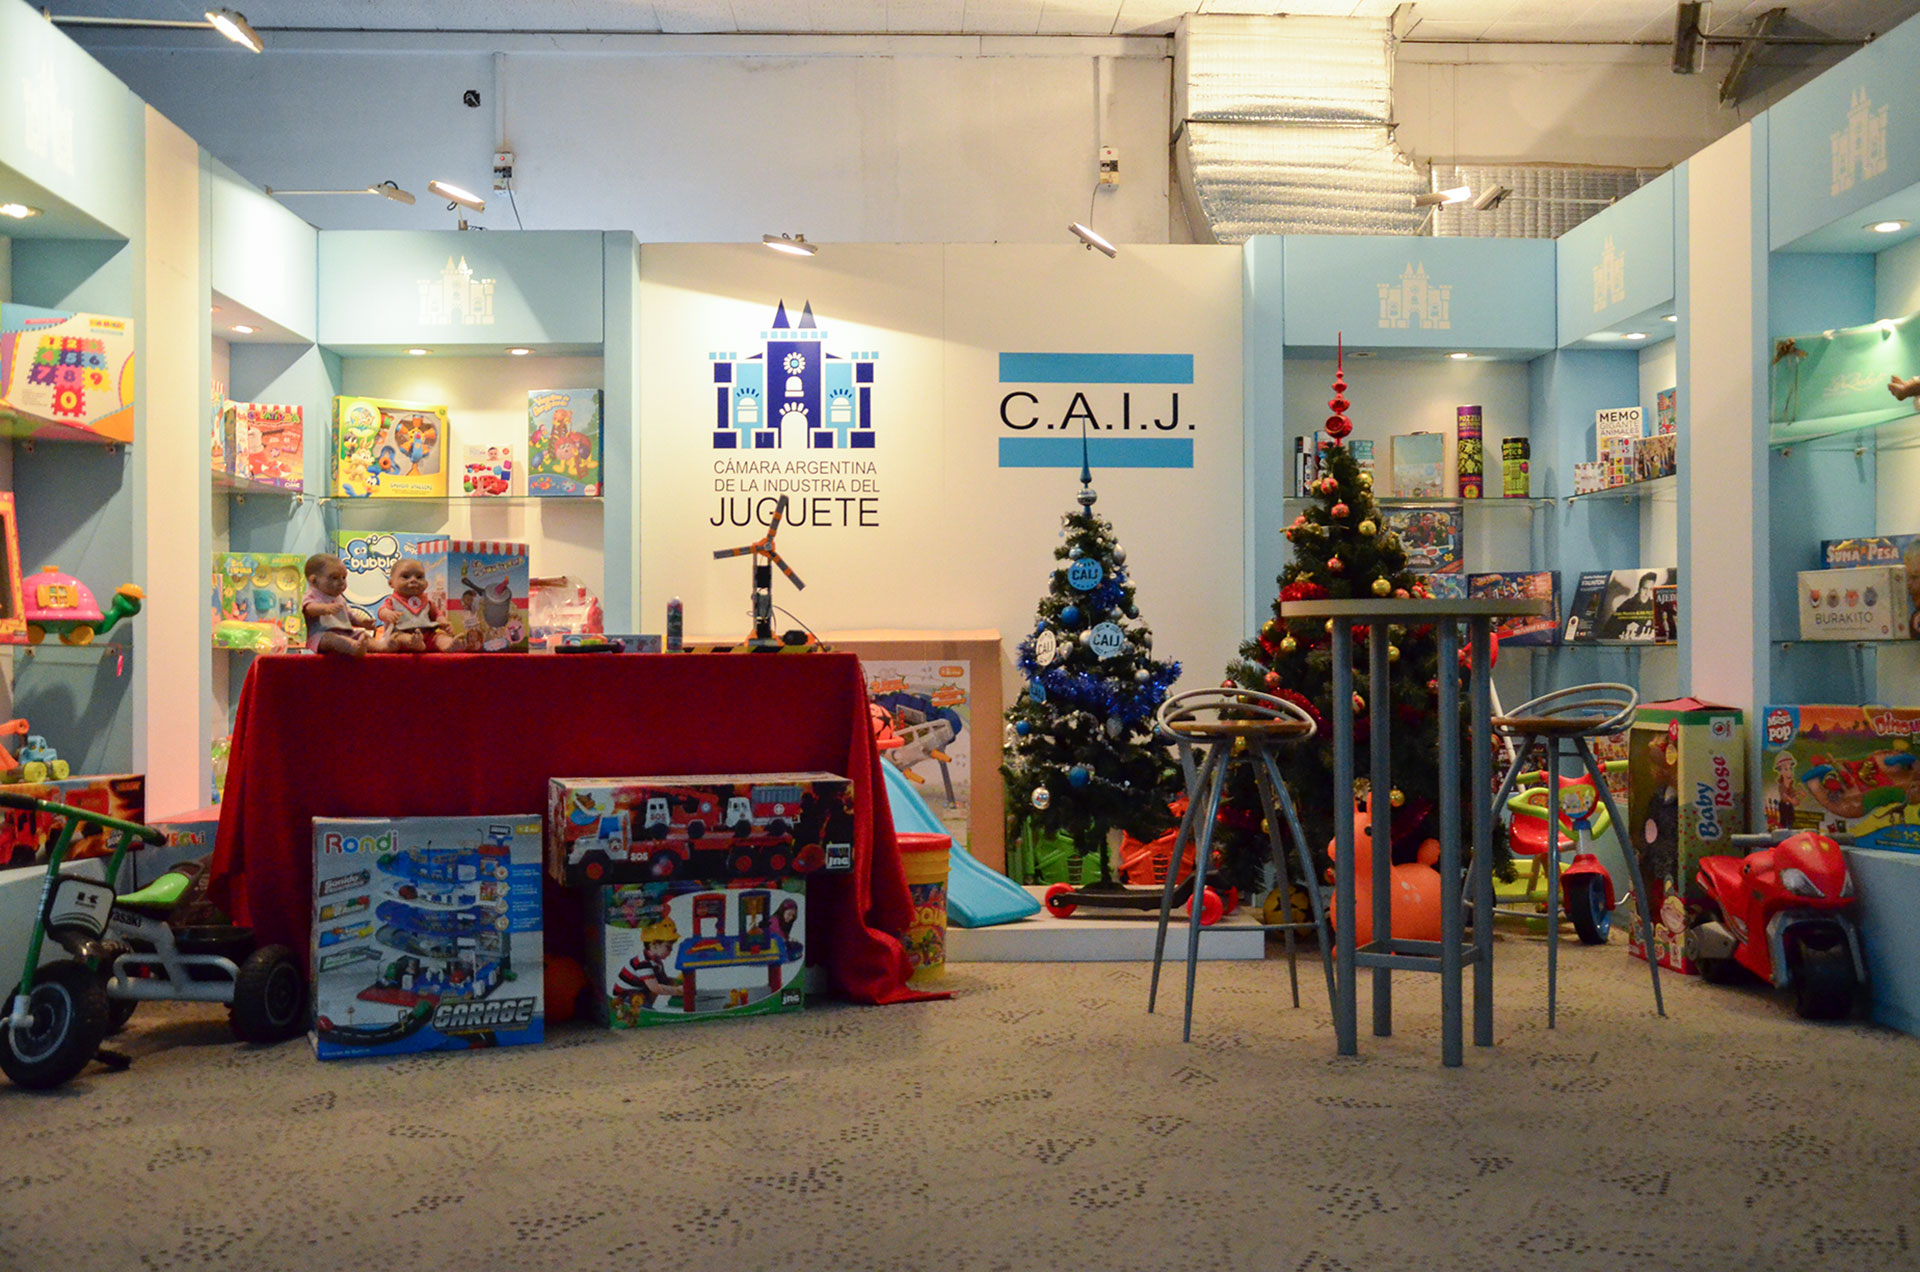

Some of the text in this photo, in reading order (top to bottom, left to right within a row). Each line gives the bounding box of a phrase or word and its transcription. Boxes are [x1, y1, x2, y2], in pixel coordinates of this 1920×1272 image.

[1000, 391, 1196, 431] C.A.I.J.
[1600, 410, 1639, 422] MEMO
[1600, 421, 1639, 429] GIGANTE
[714, 457, 877, 474] CÁMARA ARGENTINA
[714, 478, 880, 492] DE LA INDUSTRIA DEL
[710, 496, 879, 527] JUGUETE
[1072, 569, 1098, 581] CAIJ
[1815, 611, 1873, 624] BURAKITO
[1093, 634, 1120, 646] CAIJ
[1712, 756, 1733, 807] Rose
[1695, 782, 1719, 837] Baby
[325, 829, 398, 854] Rondi
[630, 852, 649, 861] SOS
[434, 998, 534, 1028] GARAGE
